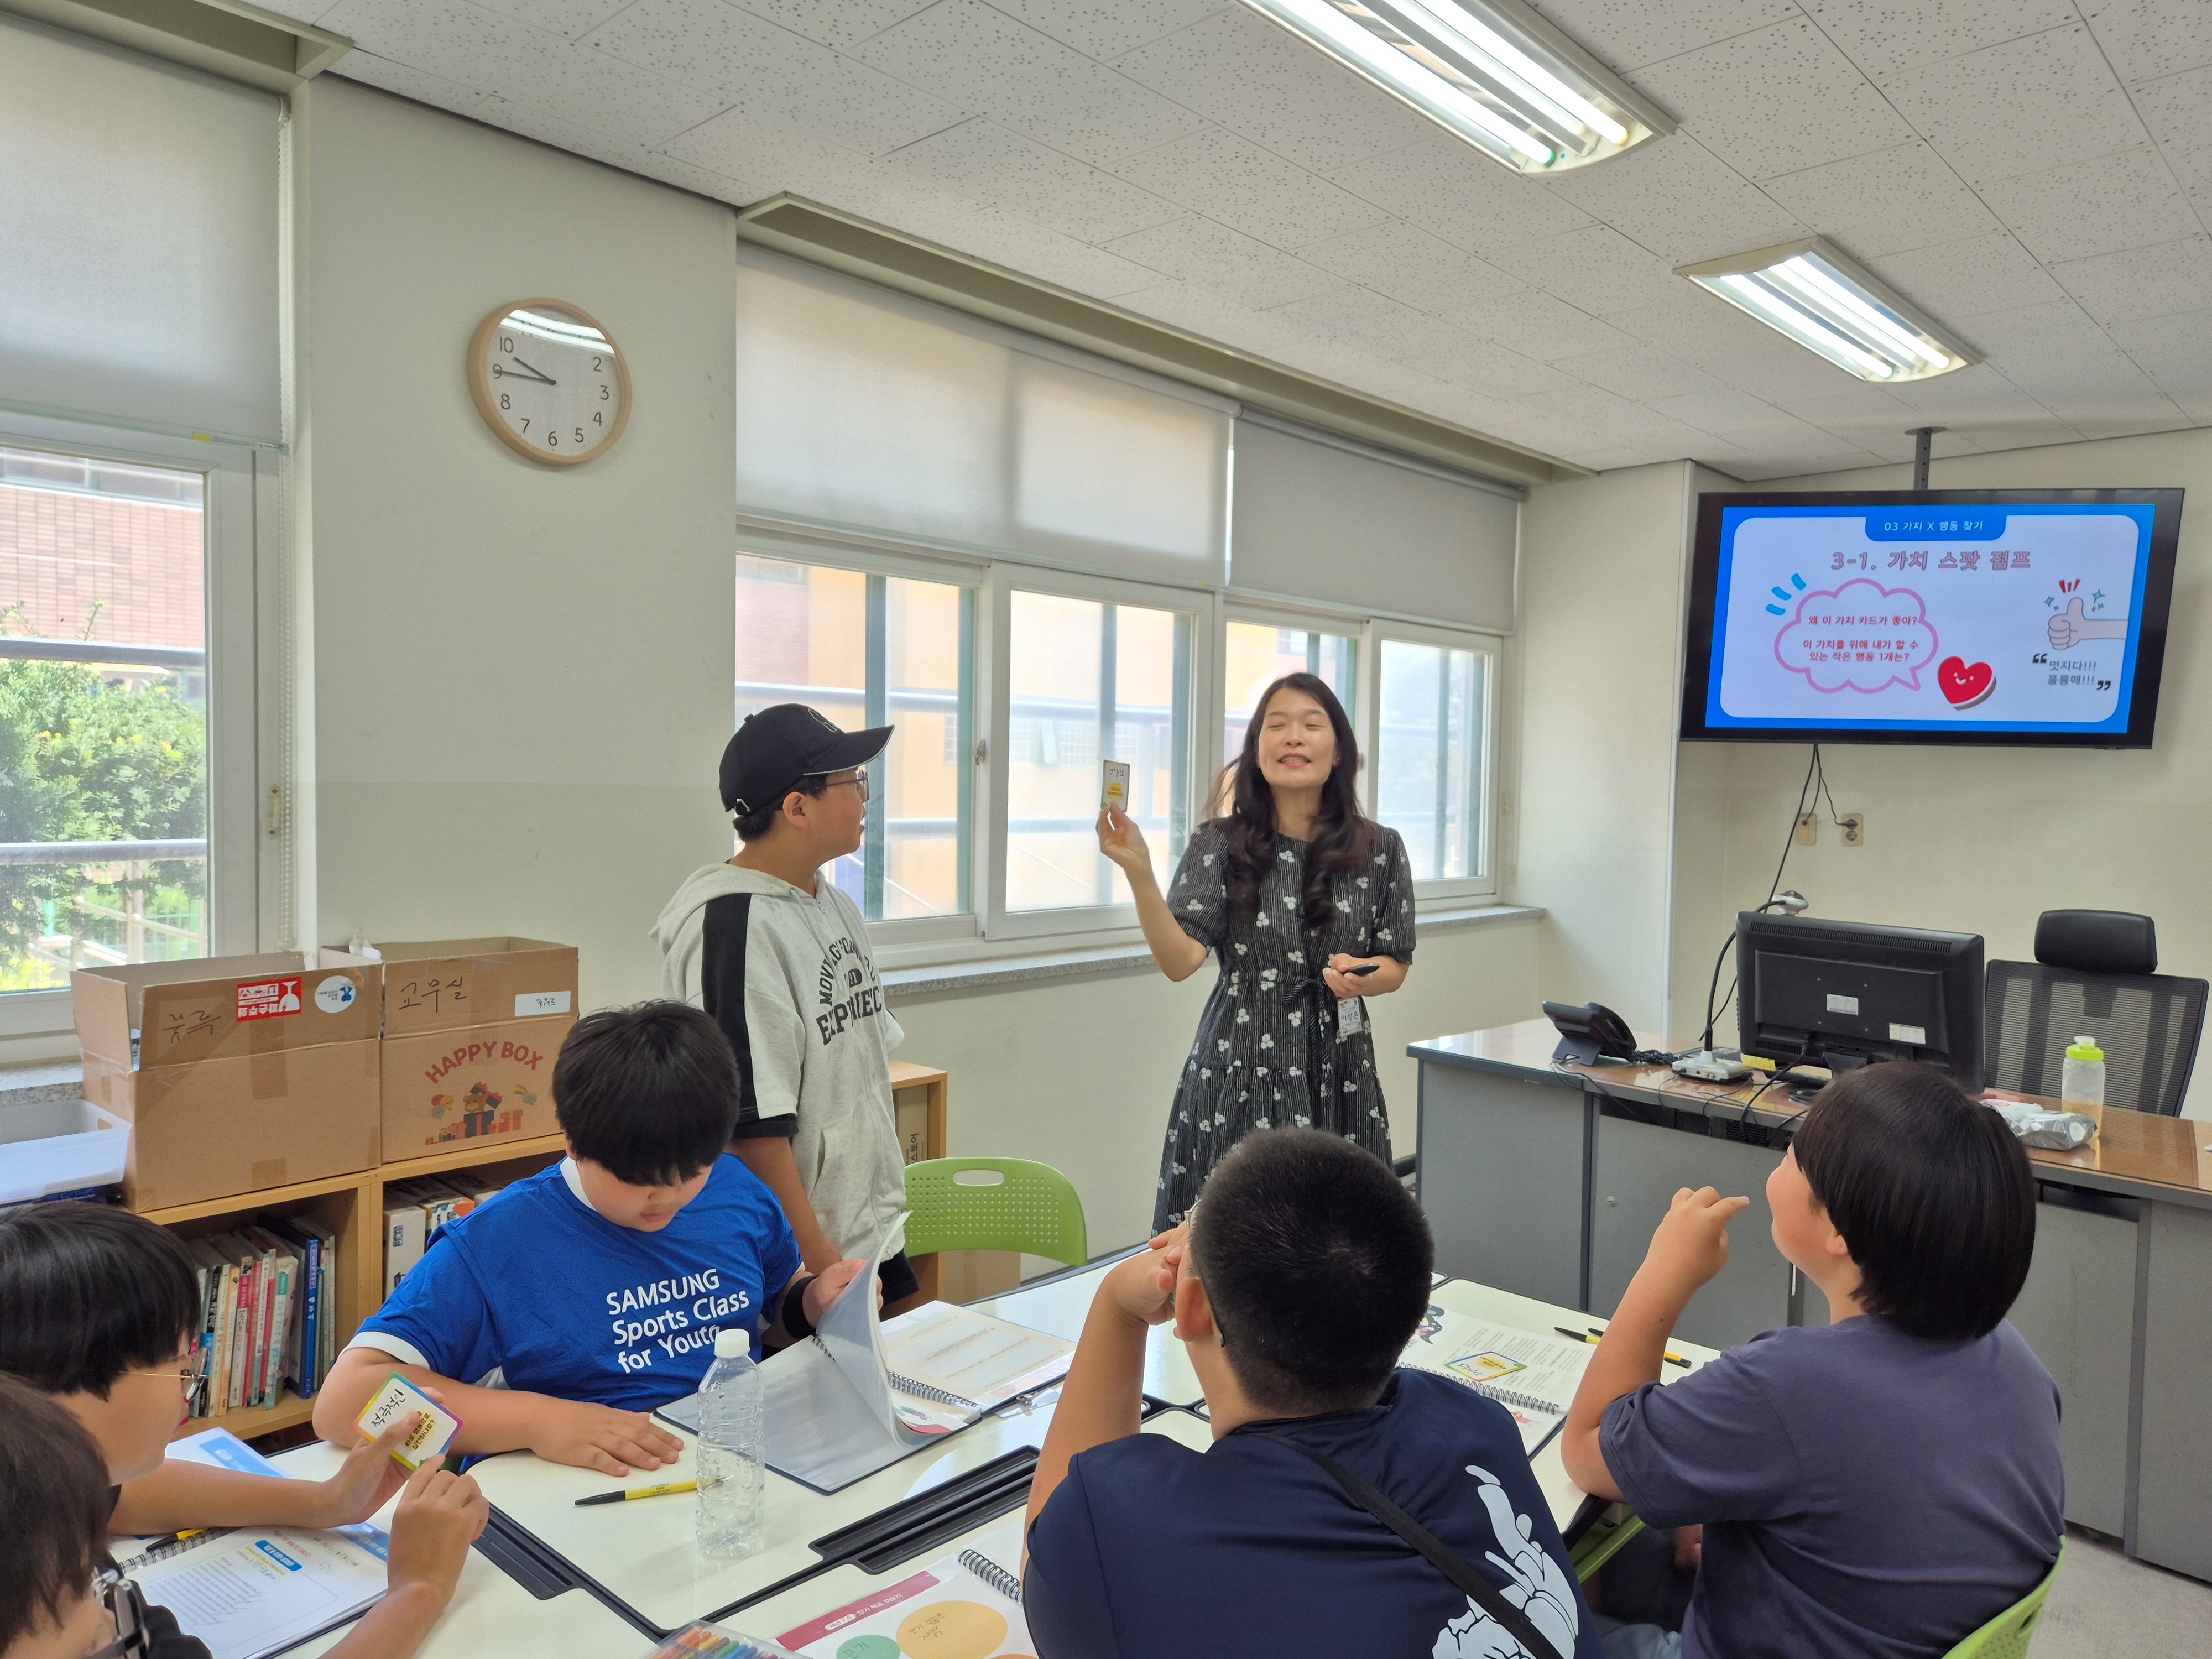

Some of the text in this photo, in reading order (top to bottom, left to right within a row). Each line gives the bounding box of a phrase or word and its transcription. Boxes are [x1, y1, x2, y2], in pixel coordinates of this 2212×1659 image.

[500, 336, 514, 353] 10
[493, 364, 502, 379] 9
[593, 357, 601, 372] 2
[600, 385, 609, 400] 3
[500, 394, 510, 410] 8
[520, 418, 530, 434] 7
[593, 411, 603, 426] 4
[548, 431, 557, 446] 6
[575, 427, 584, 443] 5
[1885, 521, 1898, 531] 03
[1903, 521, 1922, 531] 가치
[1927, 521, 1934, 531] X
[1831, 550, 2031, 571] 3-1. 가치 스팟 점프
[1808, 615, 1918, 626] 왜 이 가치 카드가 좋아?
[1803, 640, 1918, 650] 이 가치를 위해 내가 할 수
[1809, 651, 1910, 661] 있는 작은 행동 1개는?
[399, 977, 467, 1013] 교무실
[425, 1041, 544, 1083] HAPPY BOX
[606, 1268, 720, 1315] SAMSUNG
[612, 1290, 749, 1347] Sports Class
[618, 1349, 652, 1374] for
[371, 1389, 406, 1427] 적극적인
